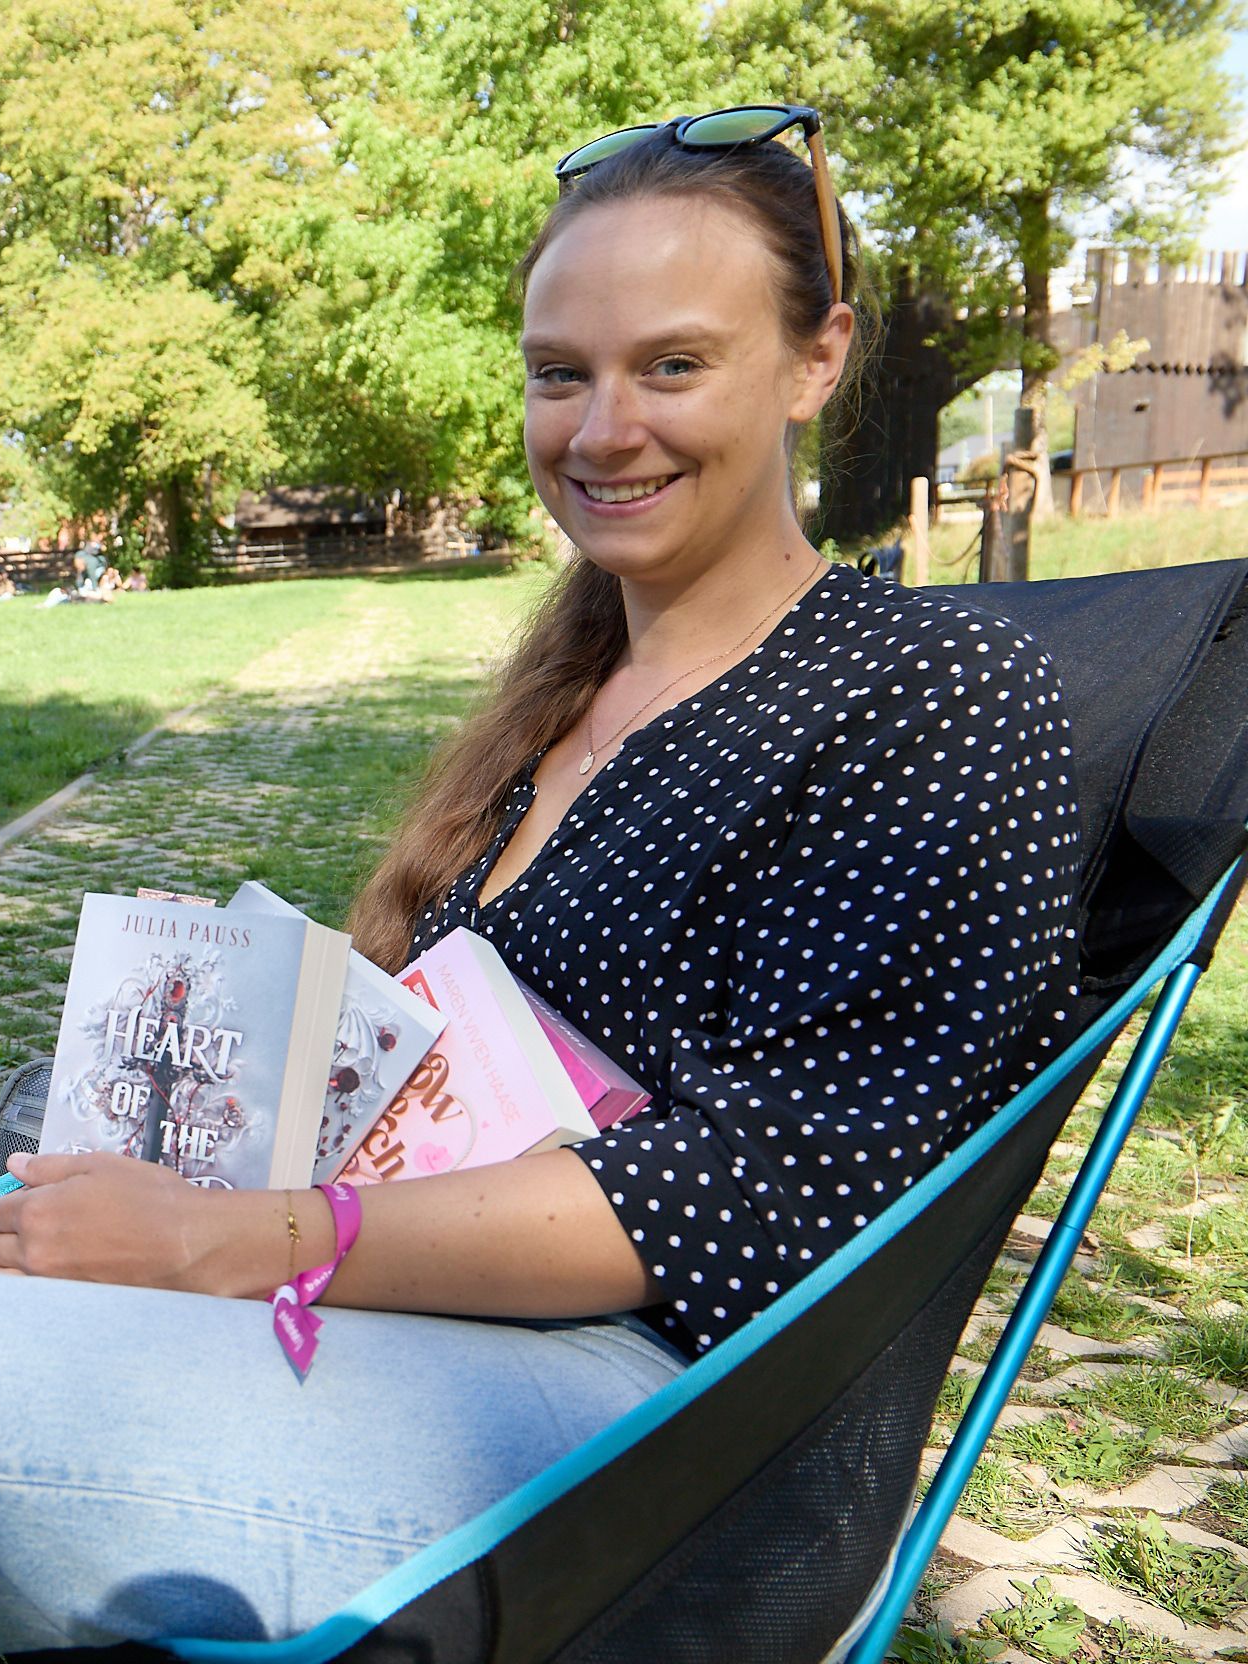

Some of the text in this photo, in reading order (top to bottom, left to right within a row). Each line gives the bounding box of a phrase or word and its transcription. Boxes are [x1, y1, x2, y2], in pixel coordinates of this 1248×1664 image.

[122, 914, 251, 948] JULIA PAUSS
[104, 1005, 243, 1083] HEART
[436, 964, 522, 1127] MAREN VIVIEN HAASE
[110, 1081, 151, 1119] OF
[159, 1120, 219, 1163] THE
